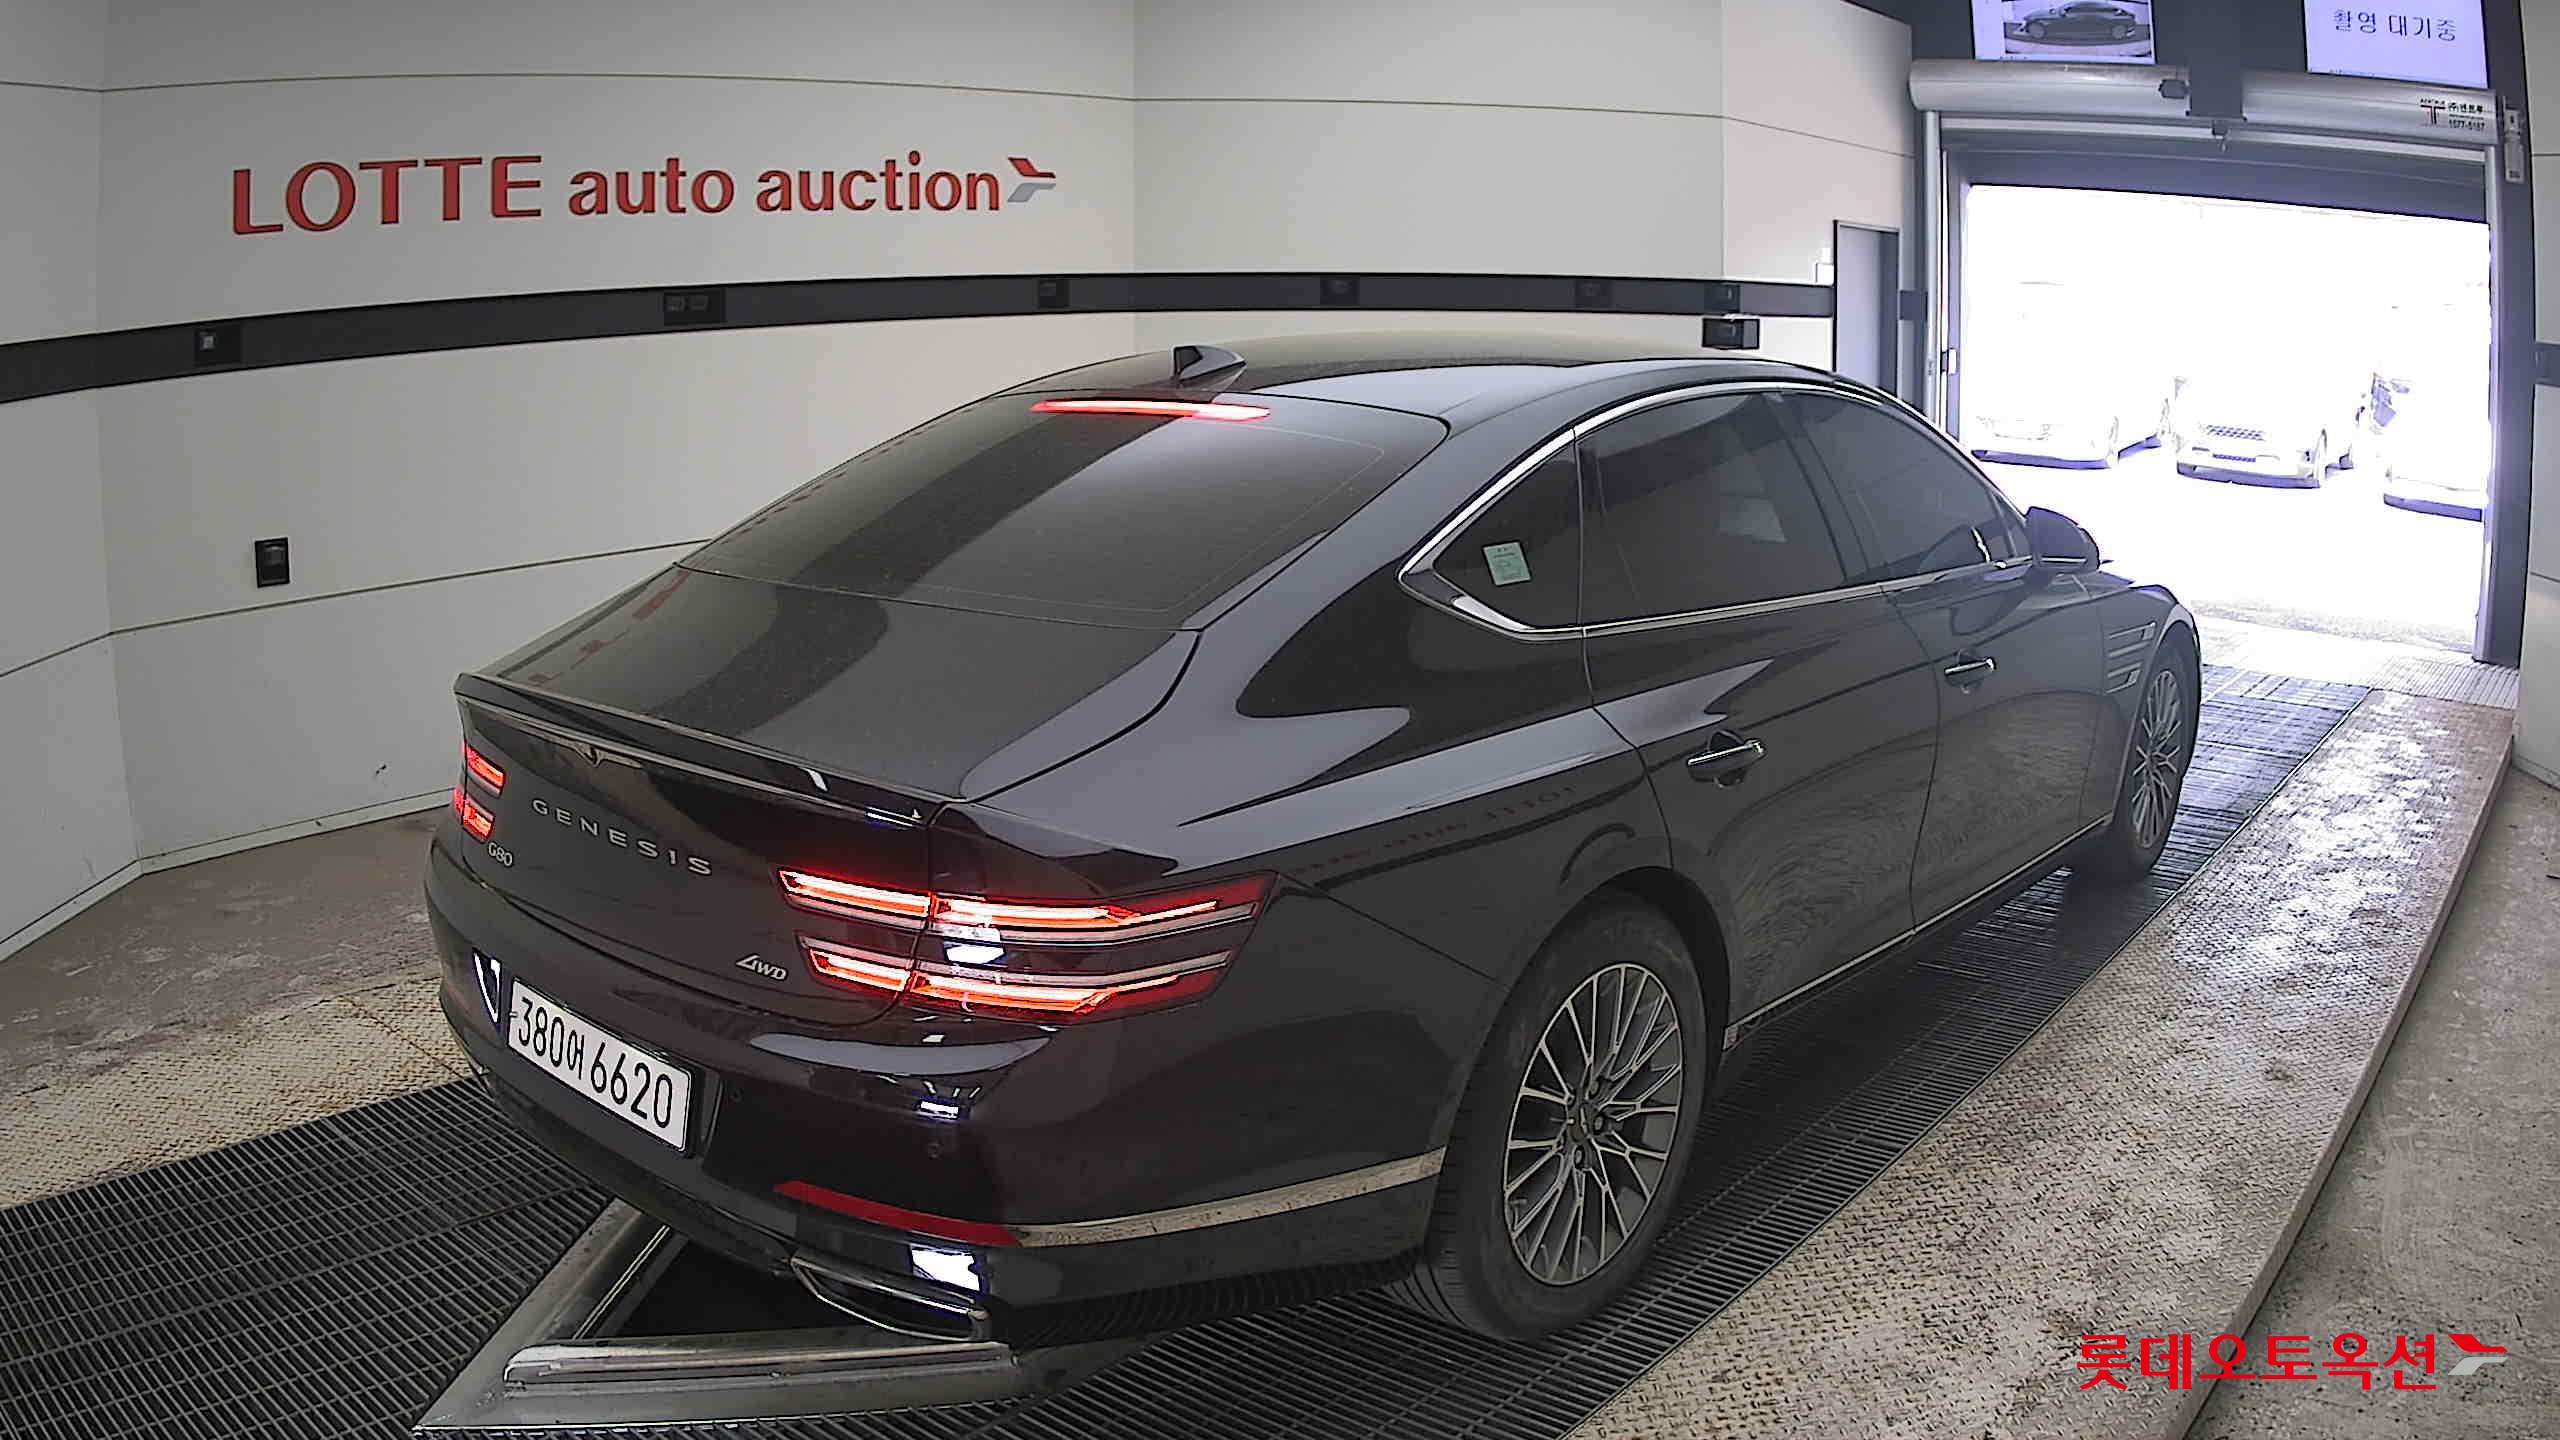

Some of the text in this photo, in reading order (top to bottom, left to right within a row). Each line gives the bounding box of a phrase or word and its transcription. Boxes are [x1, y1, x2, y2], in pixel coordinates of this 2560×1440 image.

[2334, 9, 2456, 42] 촬영 대기중
[232, 150, 1002, 236] LOTTE auto auction
[487, 841, 514, 868] G80
[531, 798, 713, 876] GENESIS
[735, 953, 788, 982] 4WD
[590, 1041, 674, 1129] 6620
